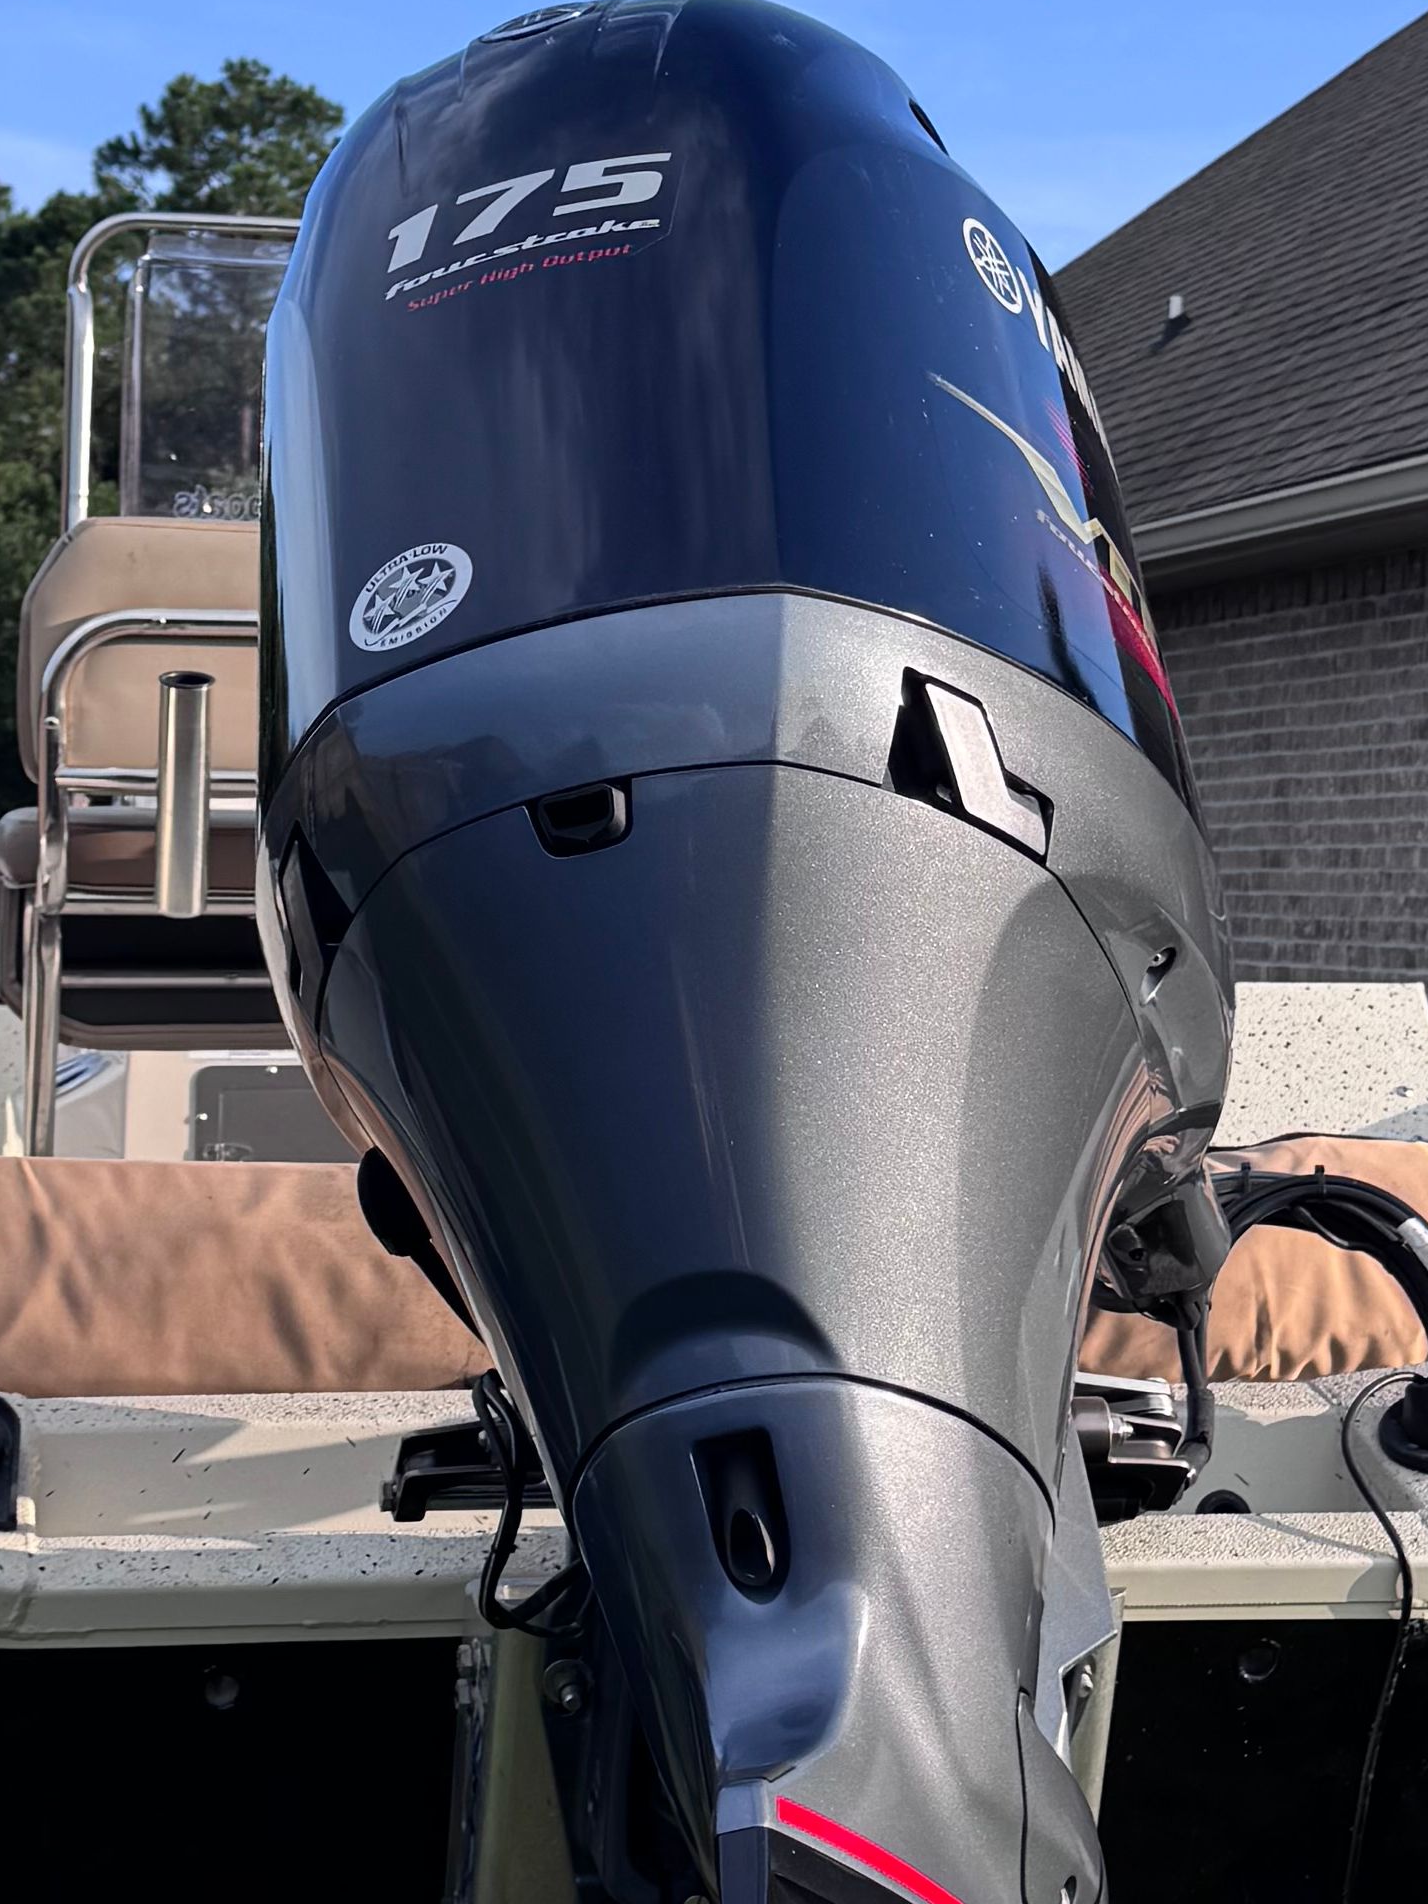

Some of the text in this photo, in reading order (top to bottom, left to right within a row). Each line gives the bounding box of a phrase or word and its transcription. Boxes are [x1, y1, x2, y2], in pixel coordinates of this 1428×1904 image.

[386, 152, 672, 274] 175
[385, 218, 661, 301] fourstroke
[406, 243, 632, 313] Super High Output
[380, 607, 448, 648] EMISSION
